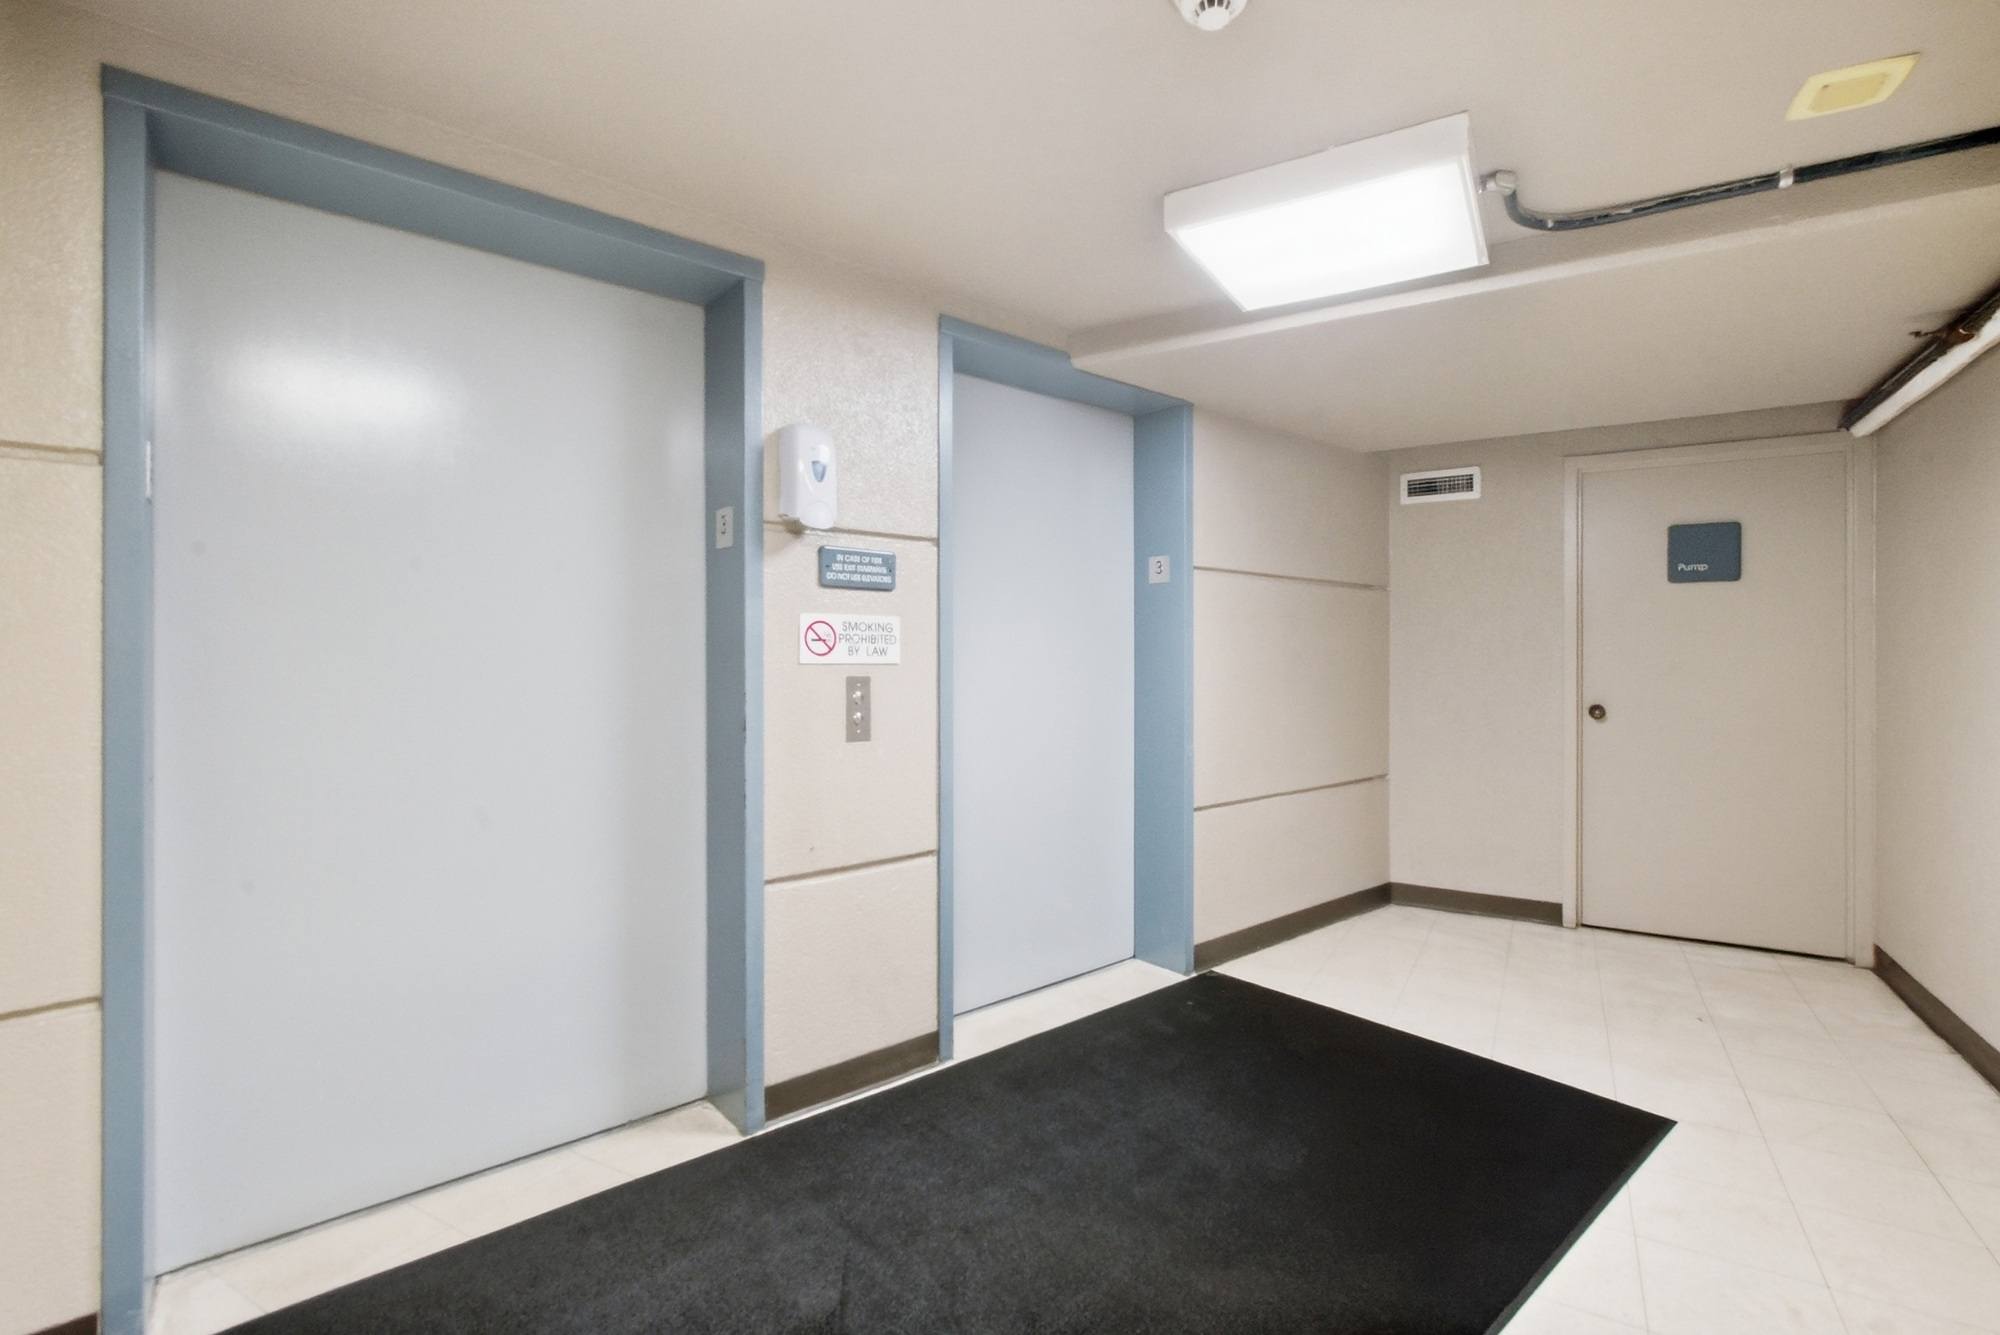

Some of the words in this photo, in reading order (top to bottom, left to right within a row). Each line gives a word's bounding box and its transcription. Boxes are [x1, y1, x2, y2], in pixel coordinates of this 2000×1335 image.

[836, 553, 844, 561] IN
[845, 554, 861, 563] CASE
[861, 555, 870, 563] OF
[1156, 560, 1163, 575] 3
[1677, 562, 1709, 572] Pump
[826, 571, 837, 580] DO
[837, 572, 850, 581] NOT
[842, 621, 893, 633] SMOKING
[838, 633, 897, 645] PROHIBITED
[847, 646, 860, 656] BY
[866, 646, 888, 657] LAW
